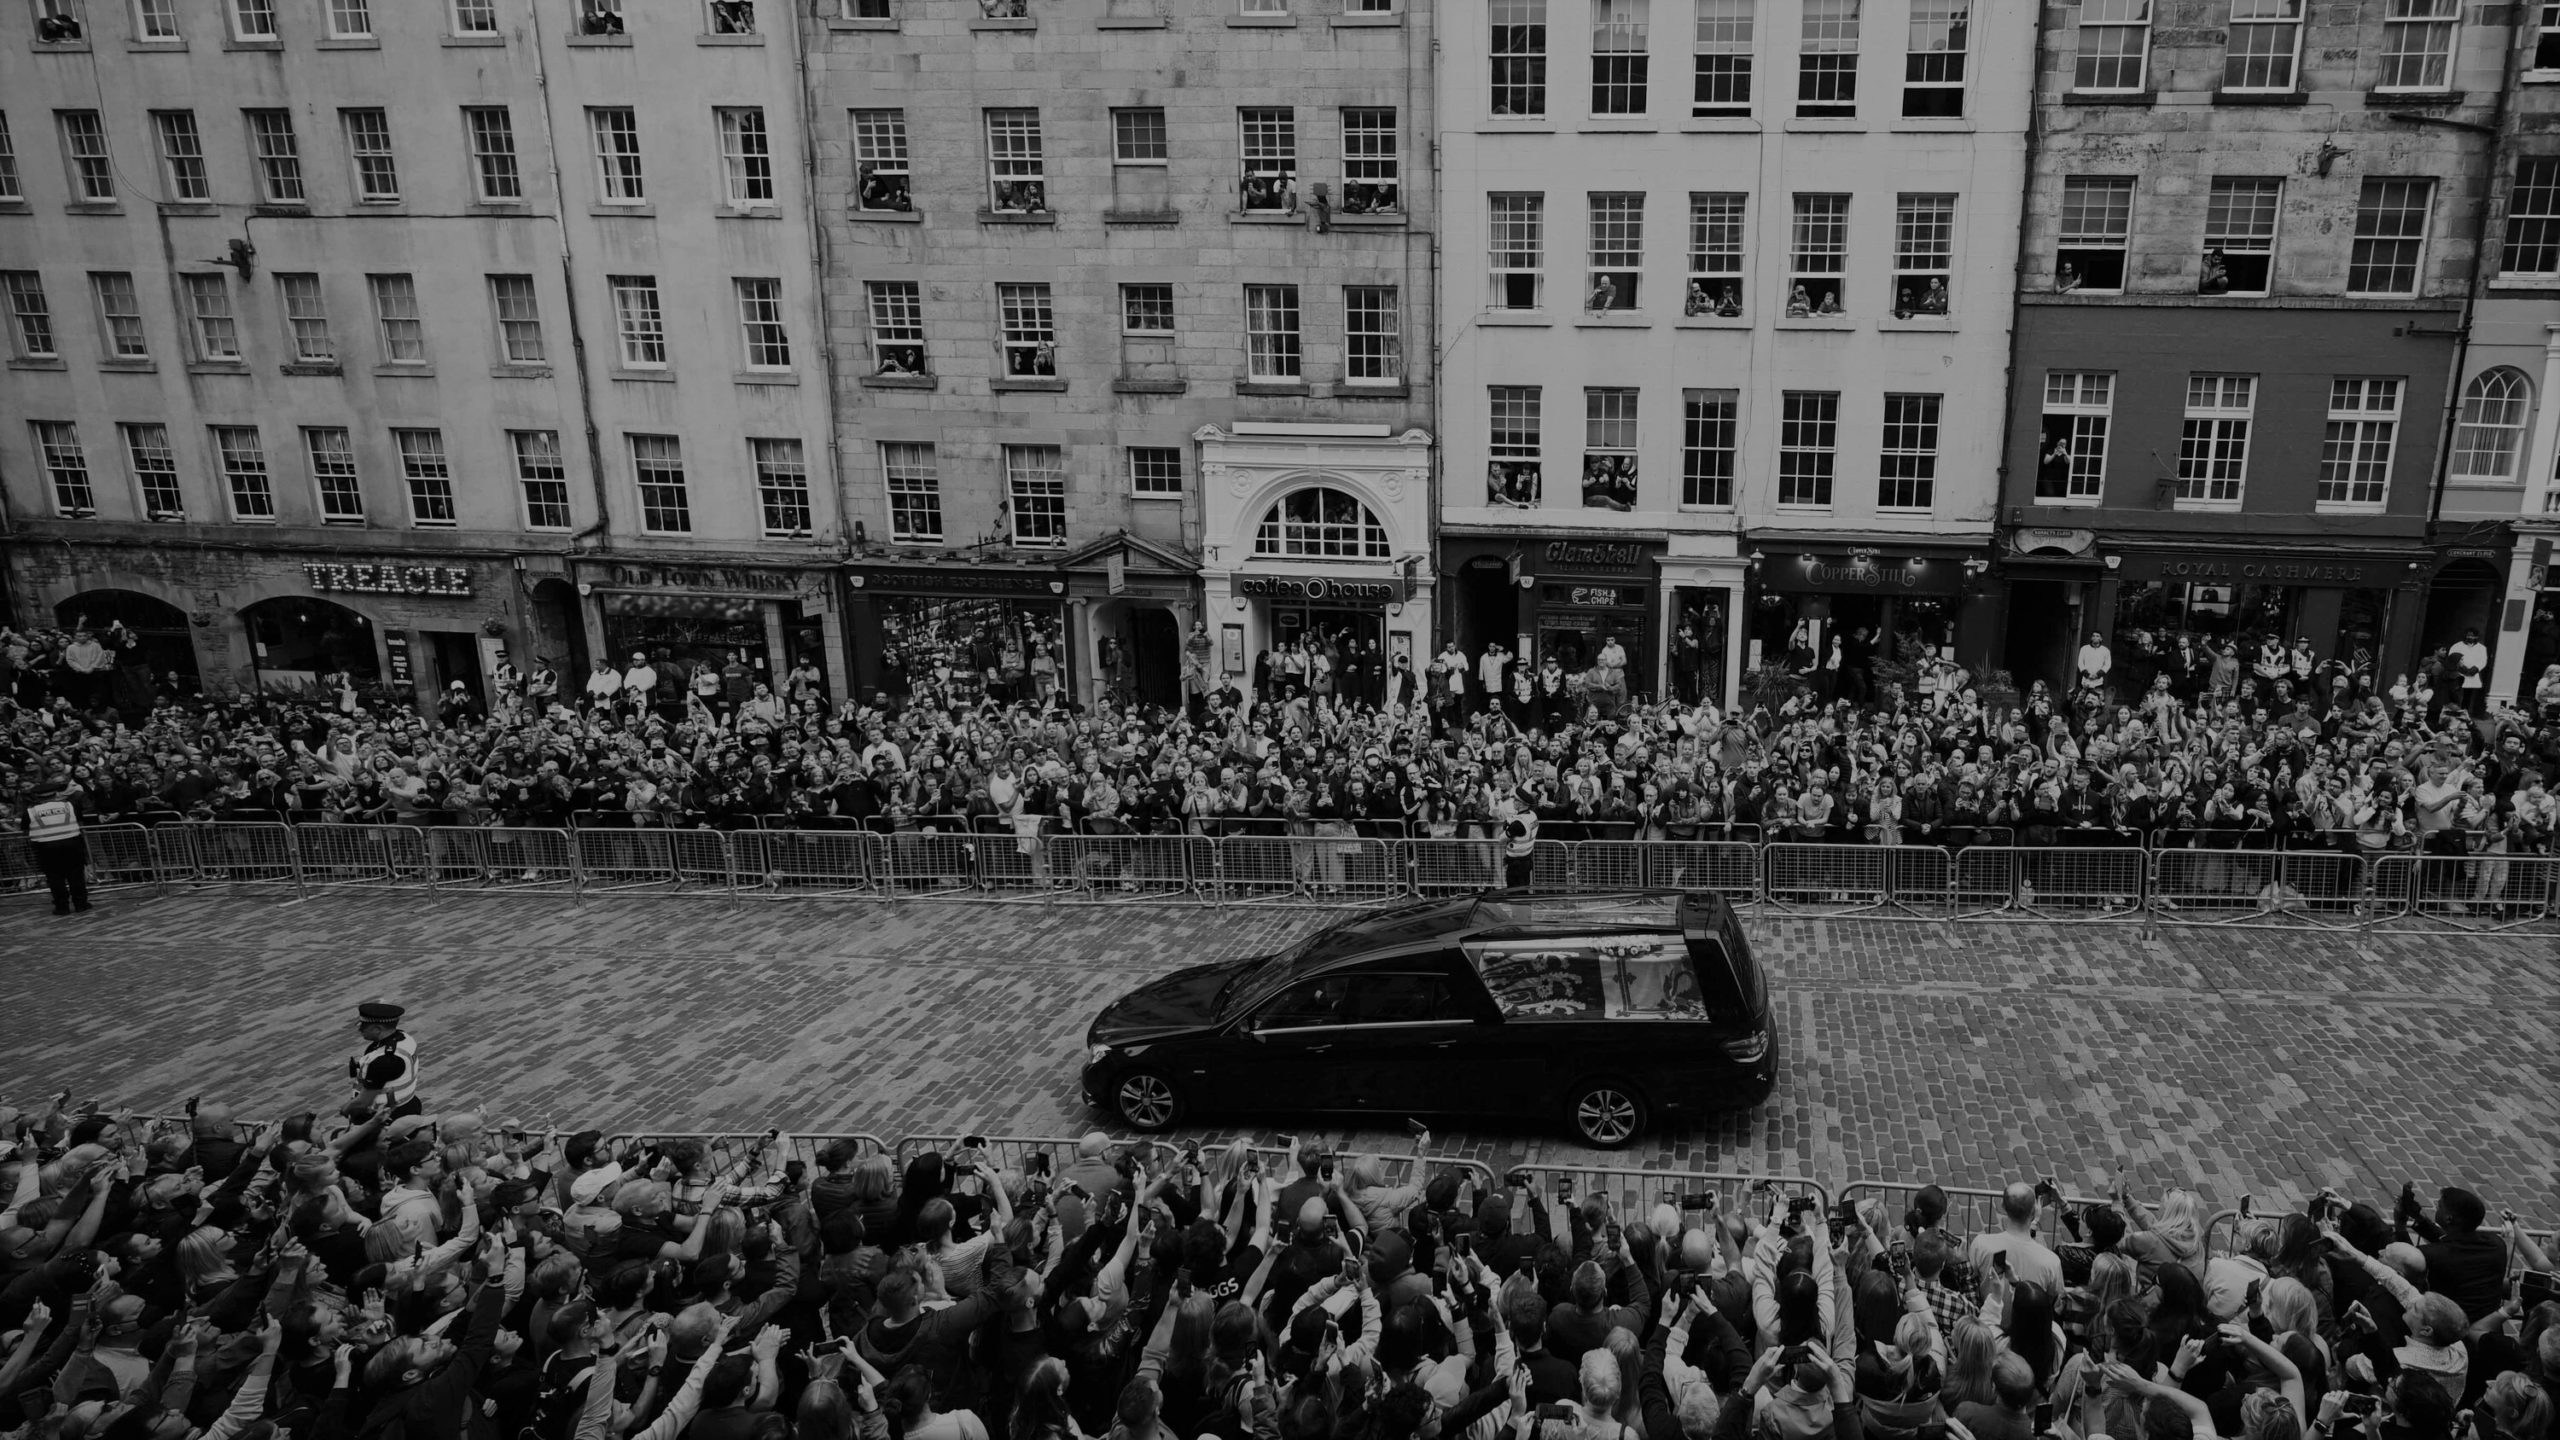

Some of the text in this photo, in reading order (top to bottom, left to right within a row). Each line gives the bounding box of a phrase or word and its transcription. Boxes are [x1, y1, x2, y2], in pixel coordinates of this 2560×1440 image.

[302, 562, 471, 596] TREACLE
[2160, 561, 2362, 582] ROYAL CASHMERE
[1241, 575, 1394, 600] coffee house
[1590, 596, 1615, 605] CHIPS
